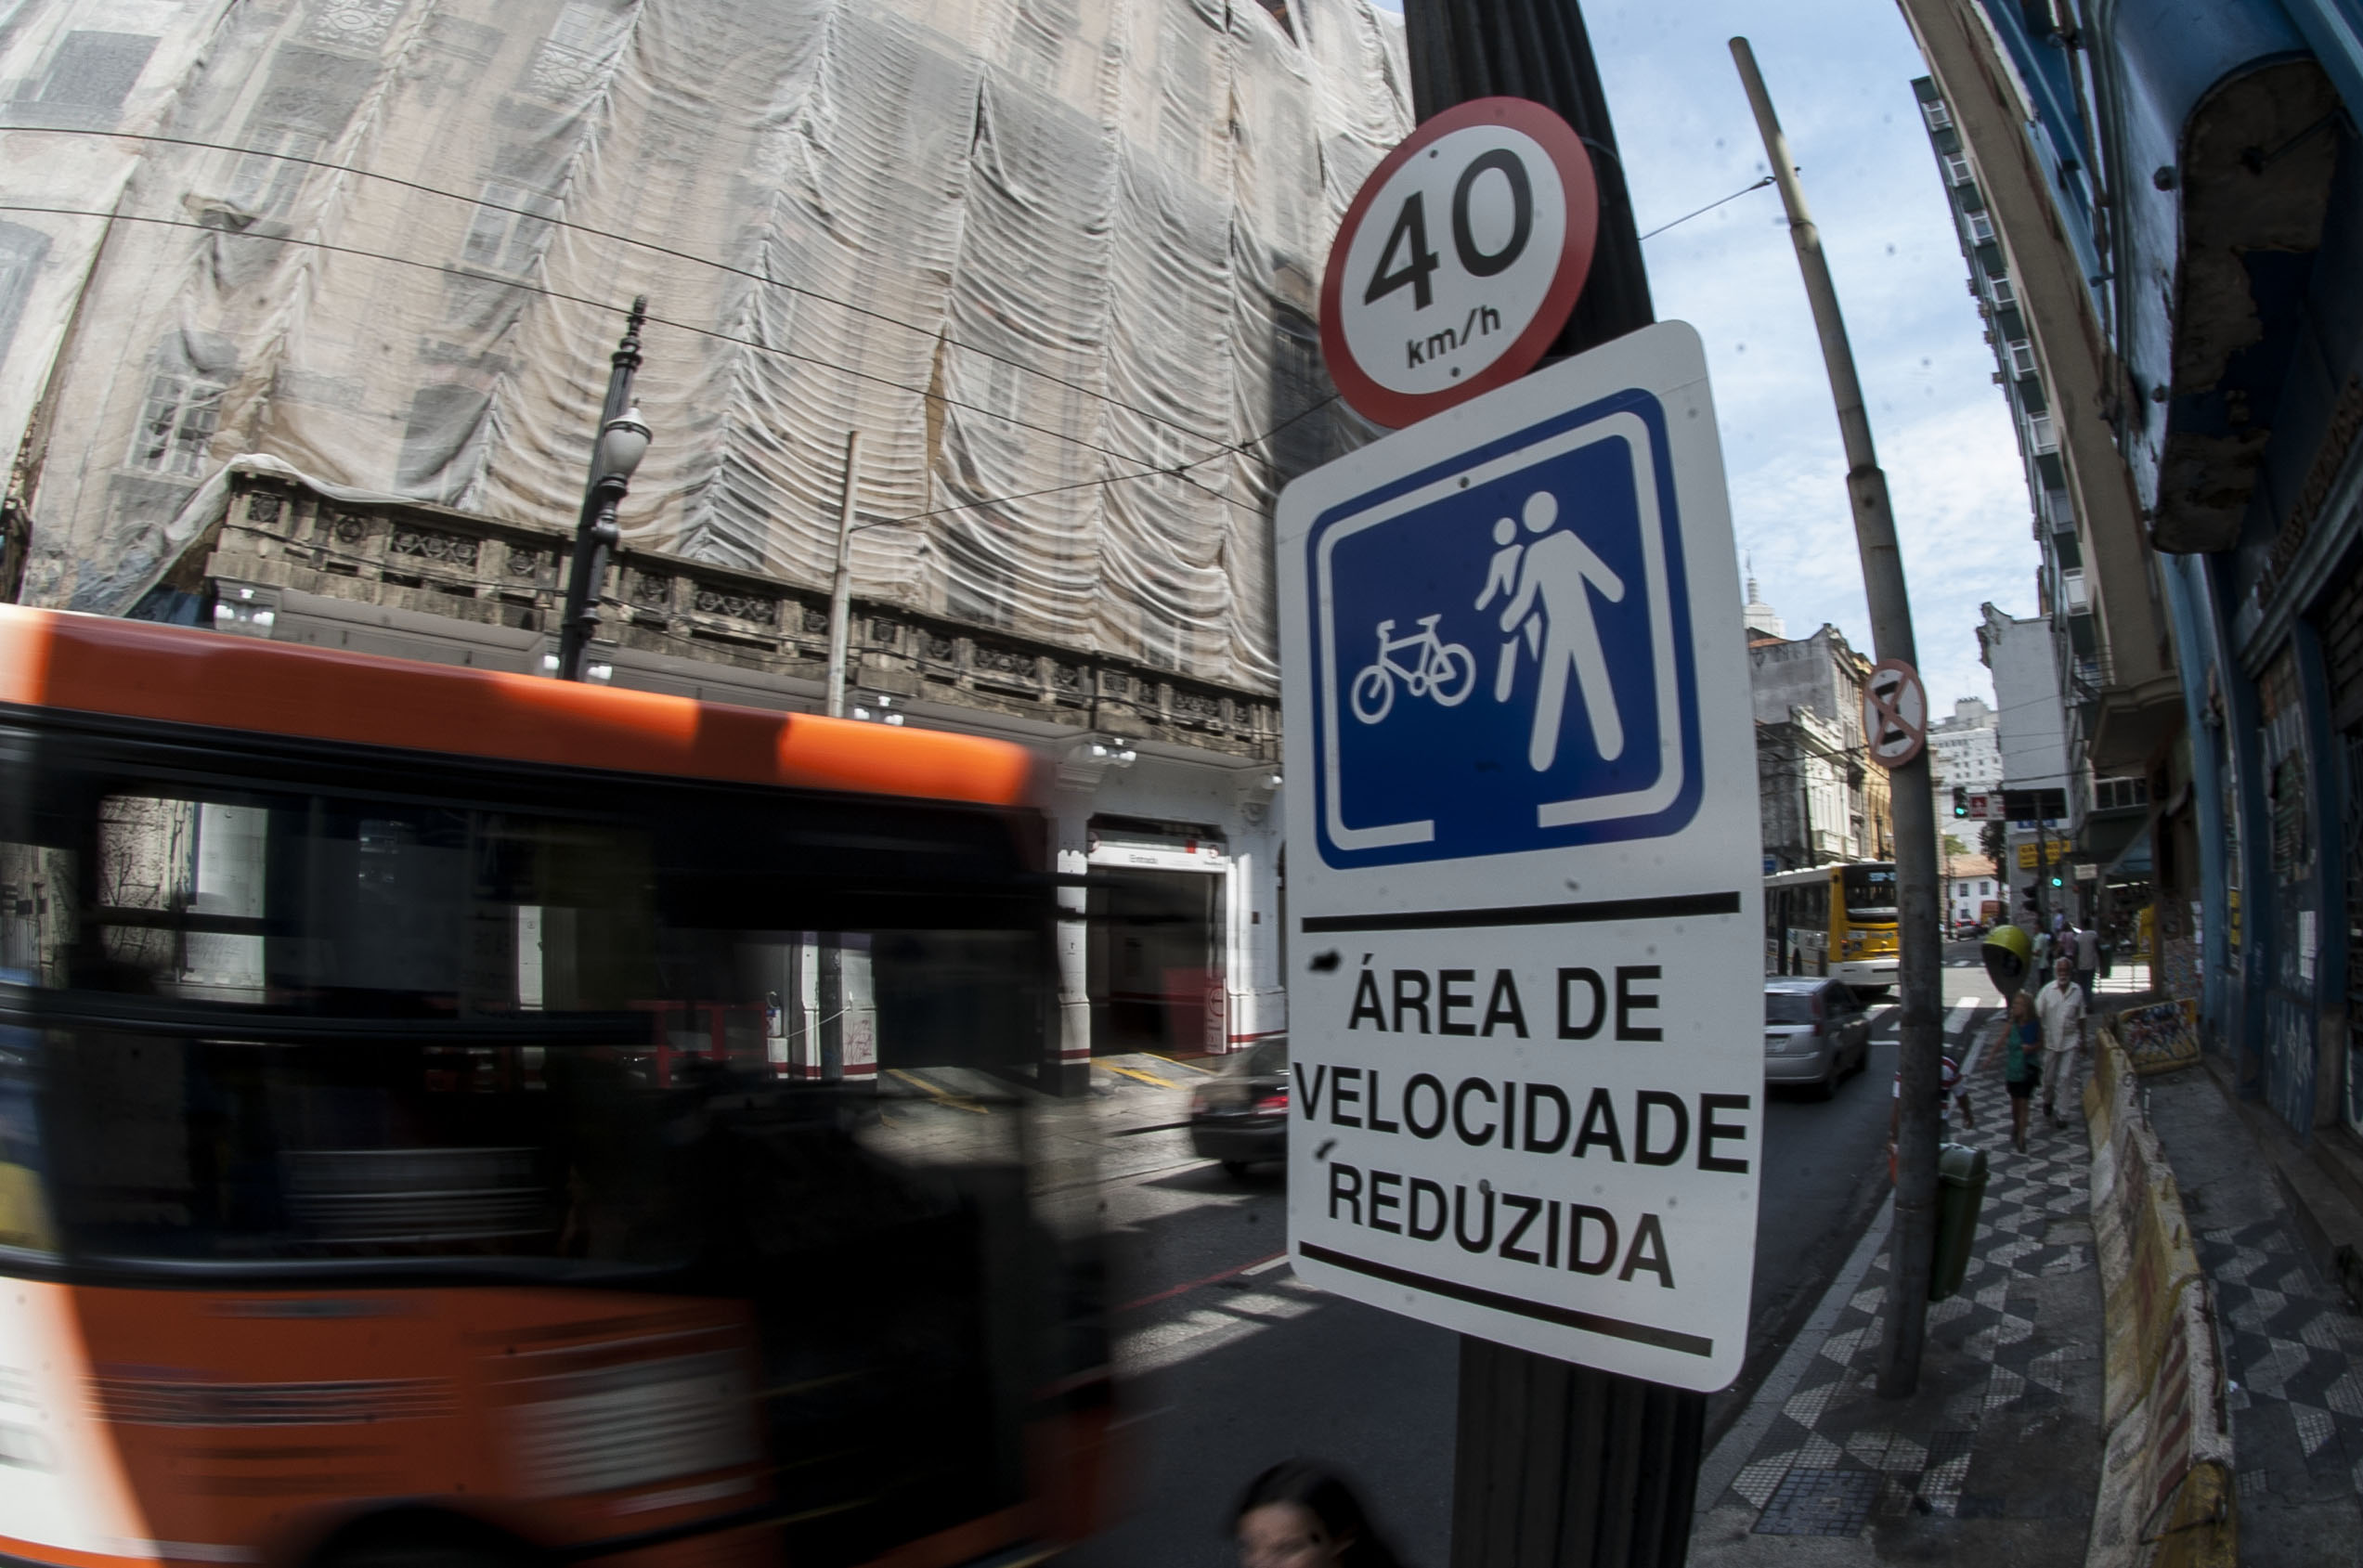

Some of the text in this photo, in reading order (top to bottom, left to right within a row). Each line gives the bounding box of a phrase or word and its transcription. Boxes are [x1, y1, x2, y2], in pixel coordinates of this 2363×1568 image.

[1363, 148, 1534, 312] 40
[1406, 305, 1501, 369] km/h
[1347, 952, 1664, 1043] ÁREA DE
[1292, 1061, 1751, 1174] VELOCIDADE
[1329, 1161, 1676, 1289] REDUZIDA
